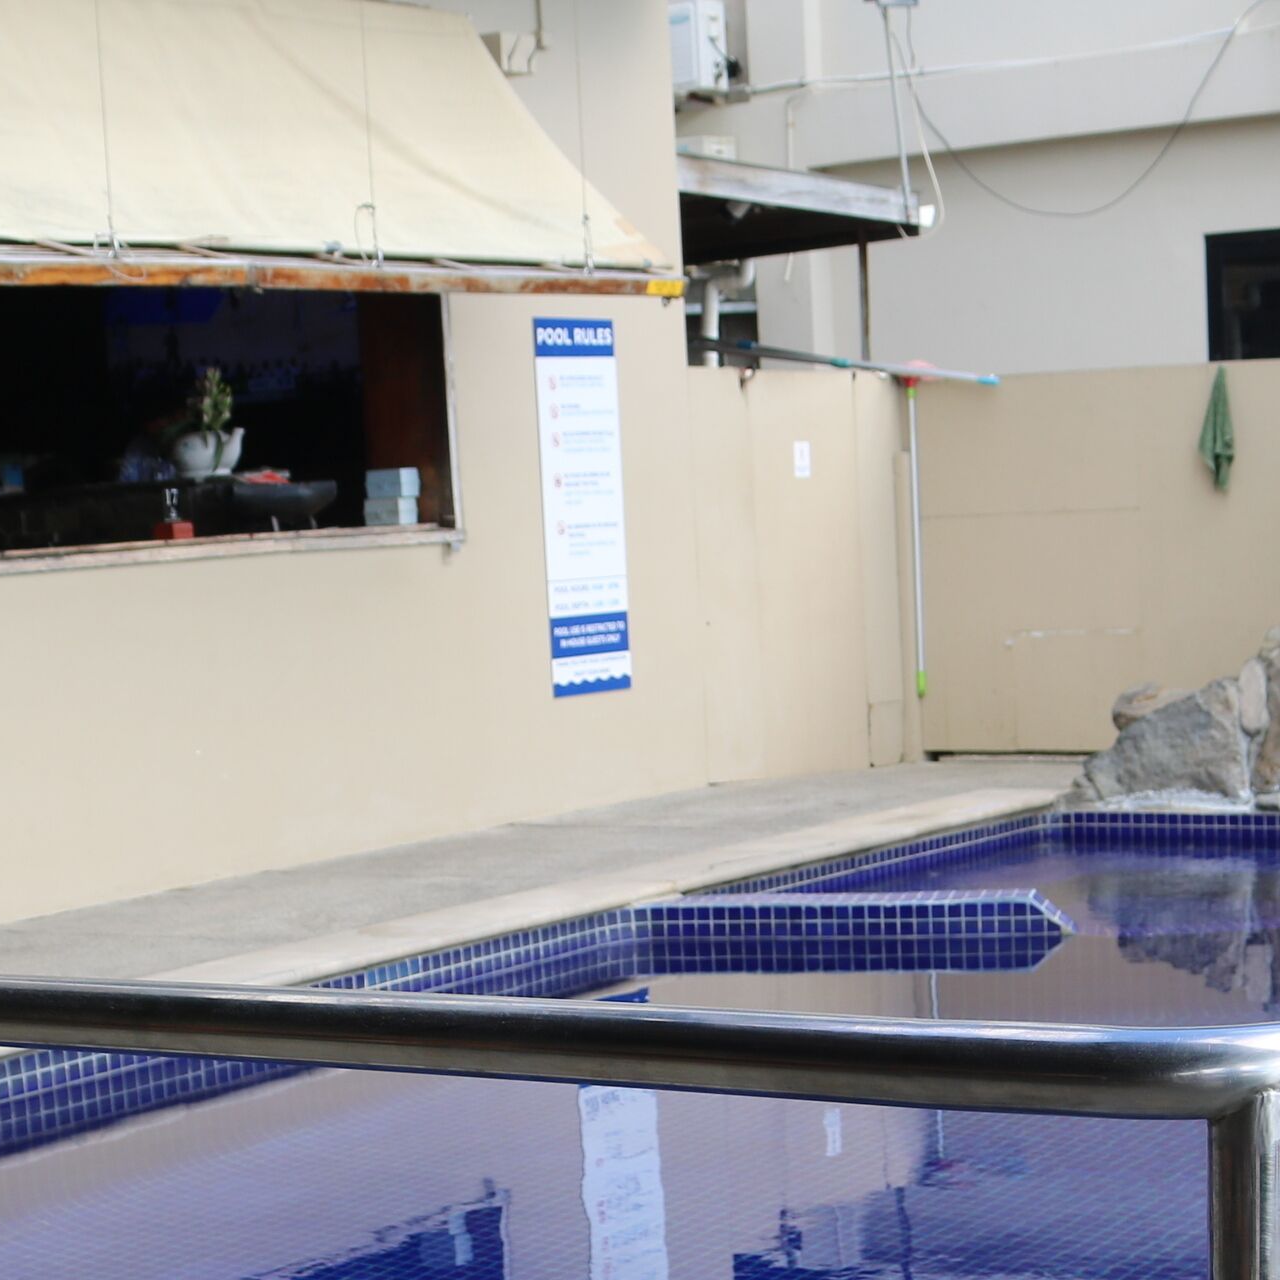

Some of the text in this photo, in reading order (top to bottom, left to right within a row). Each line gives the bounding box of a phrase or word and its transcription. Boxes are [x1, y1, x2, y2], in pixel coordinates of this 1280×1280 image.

[536, 327, 612, 346] POOL RULES
[165, 488, 178, 506] 17
